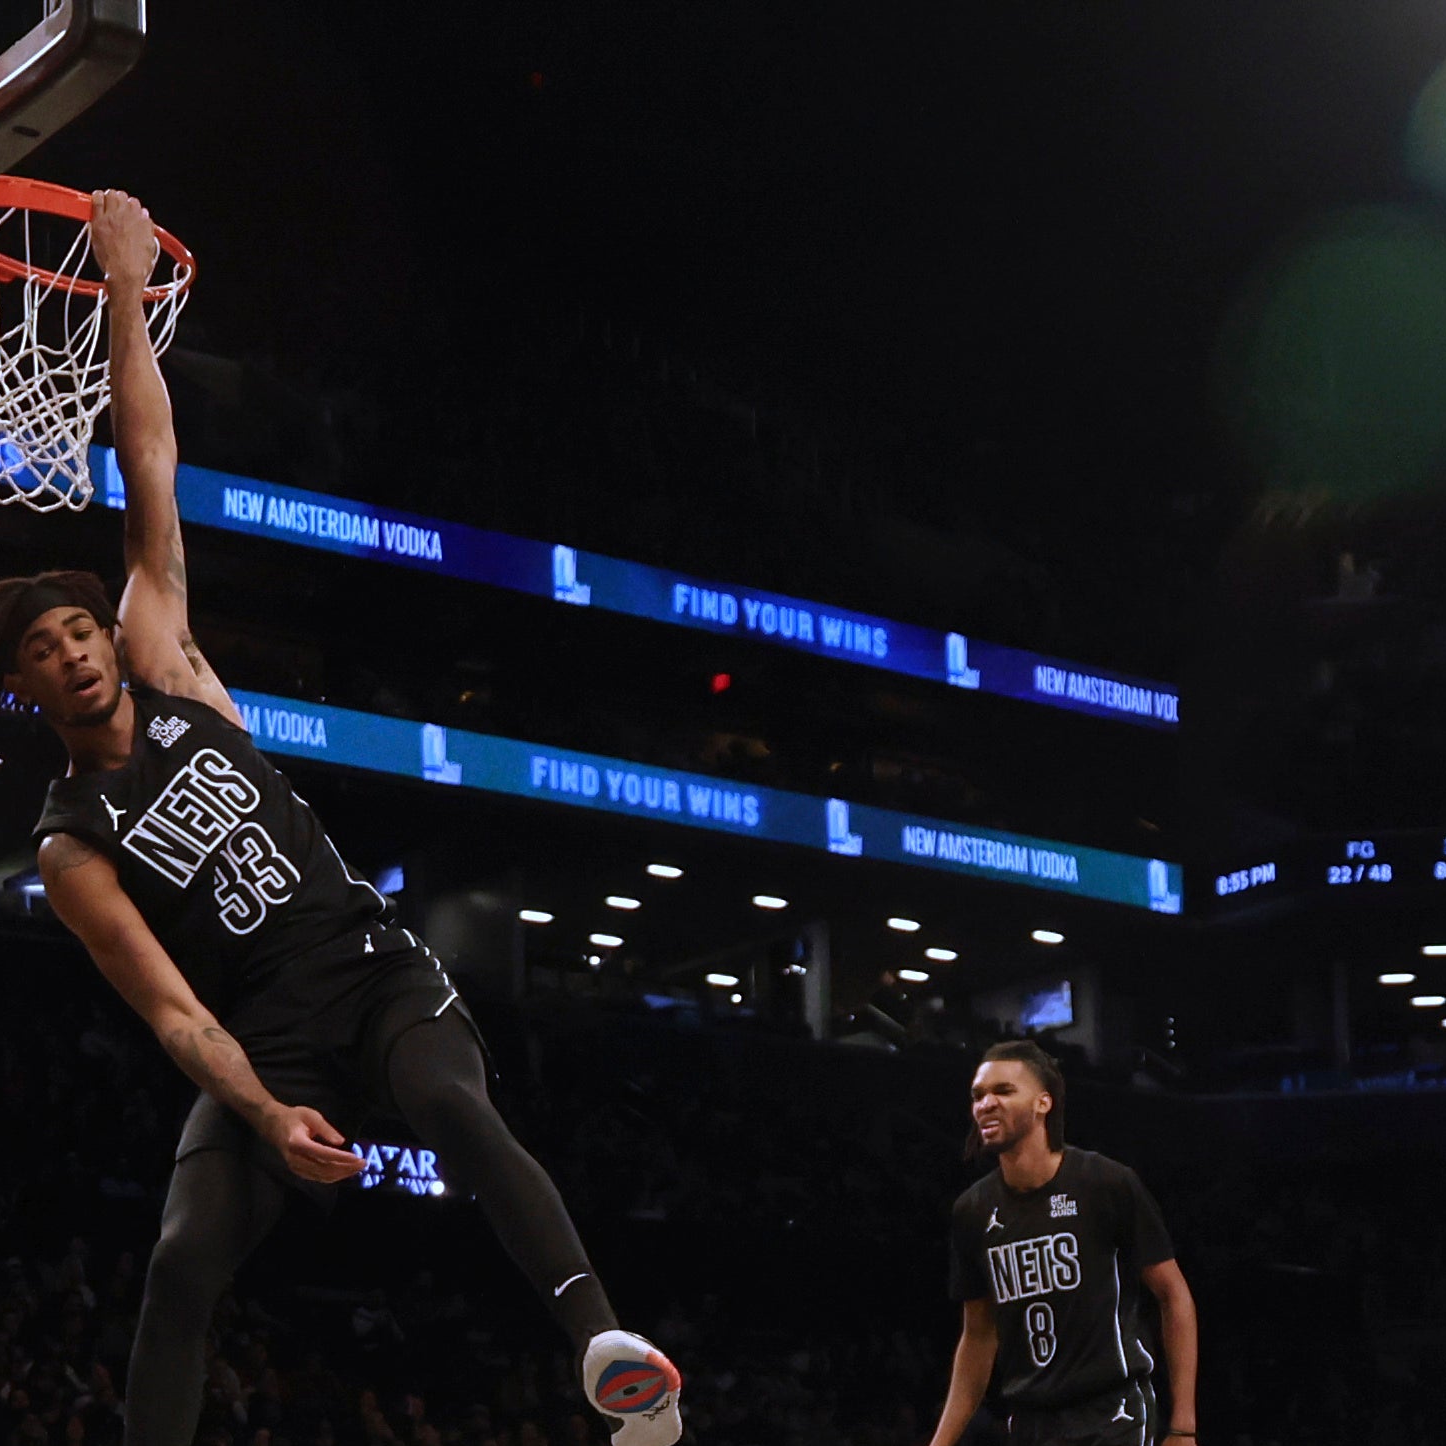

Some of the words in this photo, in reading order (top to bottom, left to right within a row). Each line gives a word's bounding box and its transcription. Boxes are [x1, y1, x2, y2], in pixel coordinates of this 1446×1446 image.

[223, 486, 265, 524] NEW
[265, 495, 380, 549] AMSTERDAM
[382, 520, 443, 562] VODKA
[673, 582, 739, 626] FIND
[742, 597, 815, 643] YOUR
[819, 613, 889, 660] WINS
[1034, 664, 1067, 696] NEW
[1066, 671, 1153, 716] AMSTERDAM
[152, 715, 182, 741] YOUR
[160, 719, 192, 748] GUIDE
[264, 706, 328, 749] VODKA
[121, 747, 261, 889] NETS
[530, 754, 600, 798] FIND
[605, 768, 682, 813] YOUR
[686, 783, 760, 828] WINS
[213, 821, 302, 935] 33
[902, 824, 937, 858] NEW
[936, 831, 1030, 874] AMSTERDAM
[1029, 847, 1079, 884] VODKA
[1249, 862, 1276, 887] PM
[1346, 840, 1376, 860] FG
[987, 1231, 1082, 1304] NETS
[1026, 1301, 1057, 1368] 8
